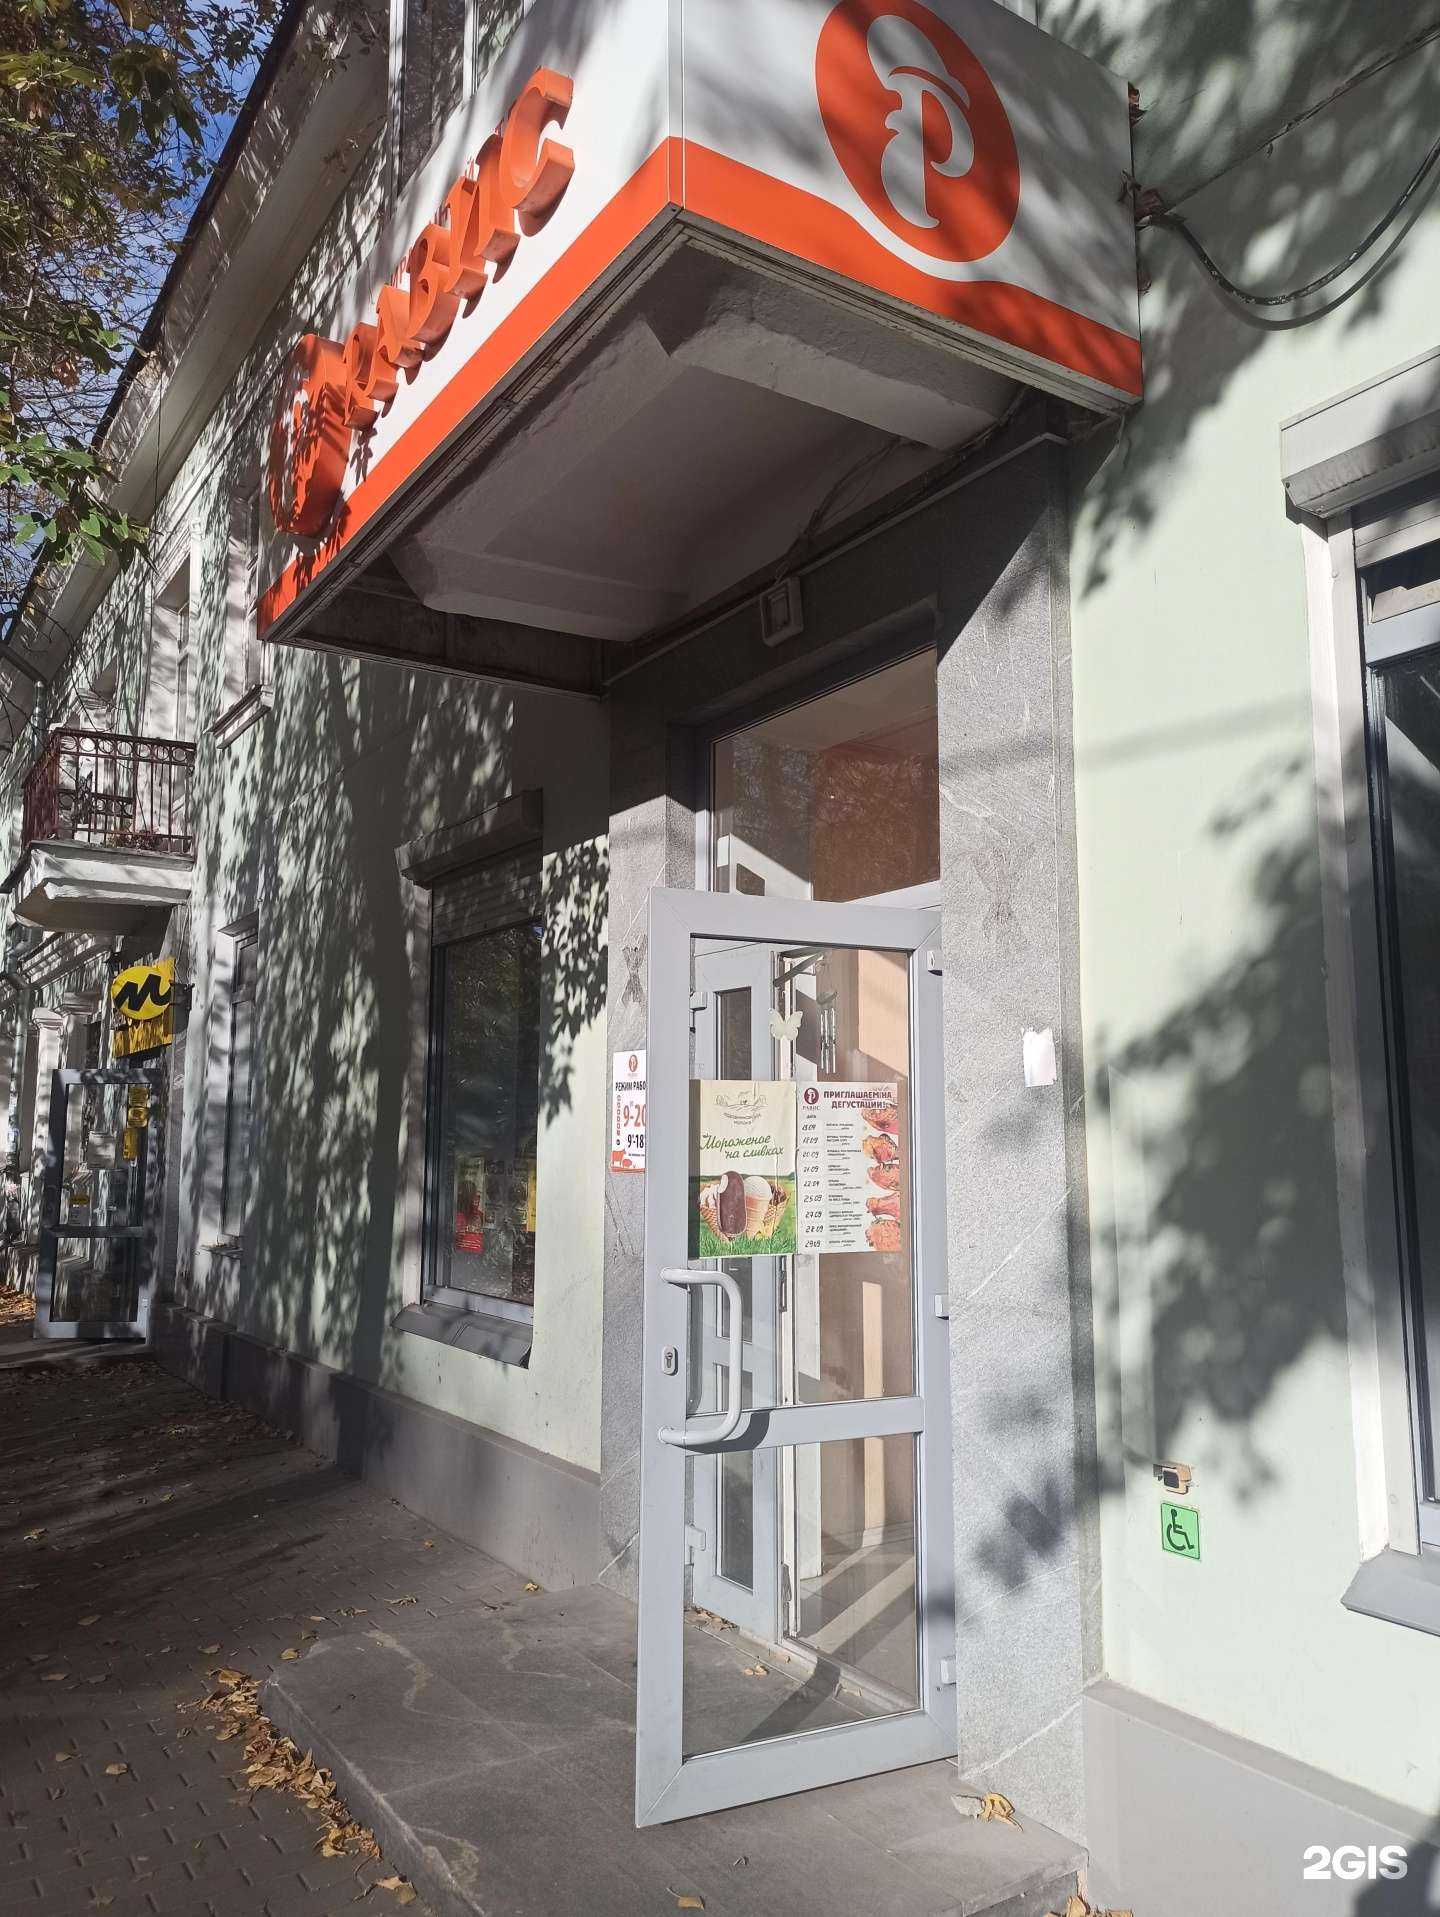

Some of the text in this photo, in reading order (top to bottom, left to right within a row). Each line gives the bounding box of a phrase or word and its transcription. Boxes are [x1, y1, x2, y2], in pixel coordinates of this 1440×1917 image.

[615, 1080, 646, 1092] РЕЖИМ РАБО
[823, 1090, 892, 1099] ПРИГЛАШАЕМ НА
[701, 1133, 771, 1152] Мороженое
[724, 1145, 784, 1159] на сливках
